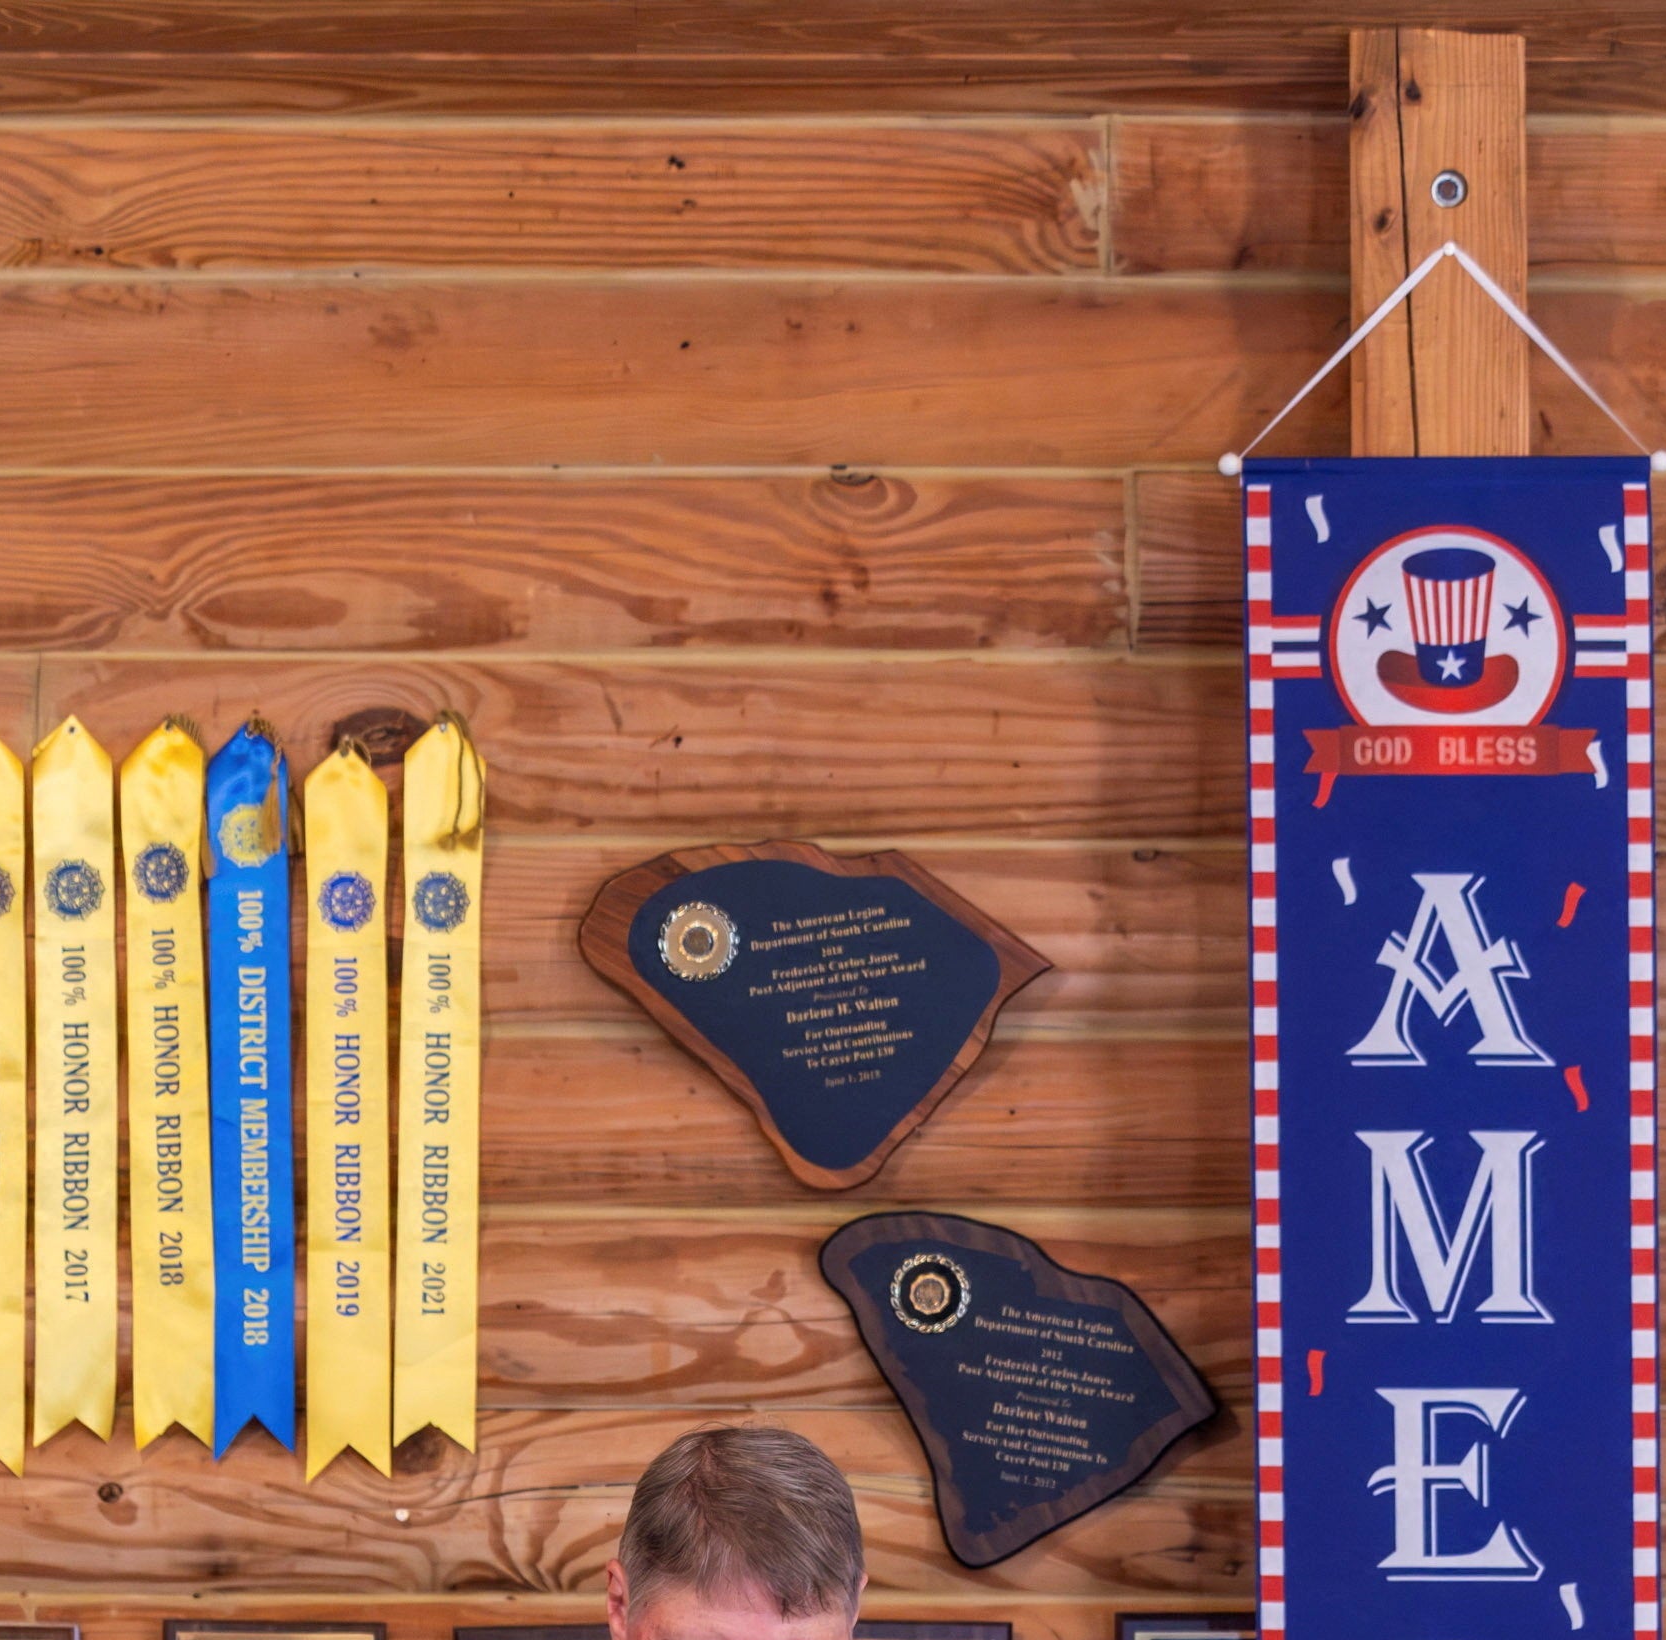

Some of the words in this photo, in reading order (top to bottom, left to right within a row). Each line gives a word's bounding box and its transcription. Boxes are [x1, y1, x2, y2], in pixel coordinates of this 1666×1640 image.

[1354, 736, 1412, 766] GOD
[1438, 736, 1537, 766] BLESS
[237, 890, 264, 953] 100%
[751, 932, 814, 952] Department
[817, 930, 828, 941] of
[830, 925, 861, 937] South
[863, 917, 911, 933] Carolina
[772, 921, 792, 932] The
[796, 912, 846, 928] American
[848, 906, 886, 921] Legion
[61, 945, 86, 1006] 100%
[151, 928, 175, 990] 100%
[334, 957, 358, 1017] 100%
[428, 952, 451, 1013] 100%
[749, 985, 773, 997] Post
[776, 976, 824, 993] Adjutant
[828, 974, 839, 984] of
[841, 972, 859, 982] the
[861, 967, 887, 980] Year
[890, 959, 926, 975] Award
[772, 961, 826, 980] Frederick
[828, 956, 866, 970] Carlos
[868, 952, 899, 965] Jones
[238, 966, 268, 1090] DISTRICT
[786, 1007, 834, 1024] Darlene
[837, 1003, 851, 1014] H.
[855, 997, 899, 1012] Walton
[63, 1022, 90, 1115] HONOR
[153, 1004, 181, 1098] HONOR
[334, 1034, 360, 1126] HONOR
[424, 1031, 451, 1126] HONOR
[63, 1132, 90, 1231] RIBBON
[155, 1114, 184, 1213] RIBBON
[239, 1098, 271, 1273] MEMBERSHIP
[335, 1144, 361, 1243] RIBBON
[422, 1145, 449, 1244] RIBBON
[64, 1249, 89, 1303] 2017
[159, 1231, 184, 1288] 2018
[336, 1260, 360, 1317] 2019
[421, 1262, 445, 1316] 2021
[243, 1288, 271, 1346] 2018
[993, 1402, 1040, 1421] Darlene
[1044, 1411, 1087, 1429] Walton
